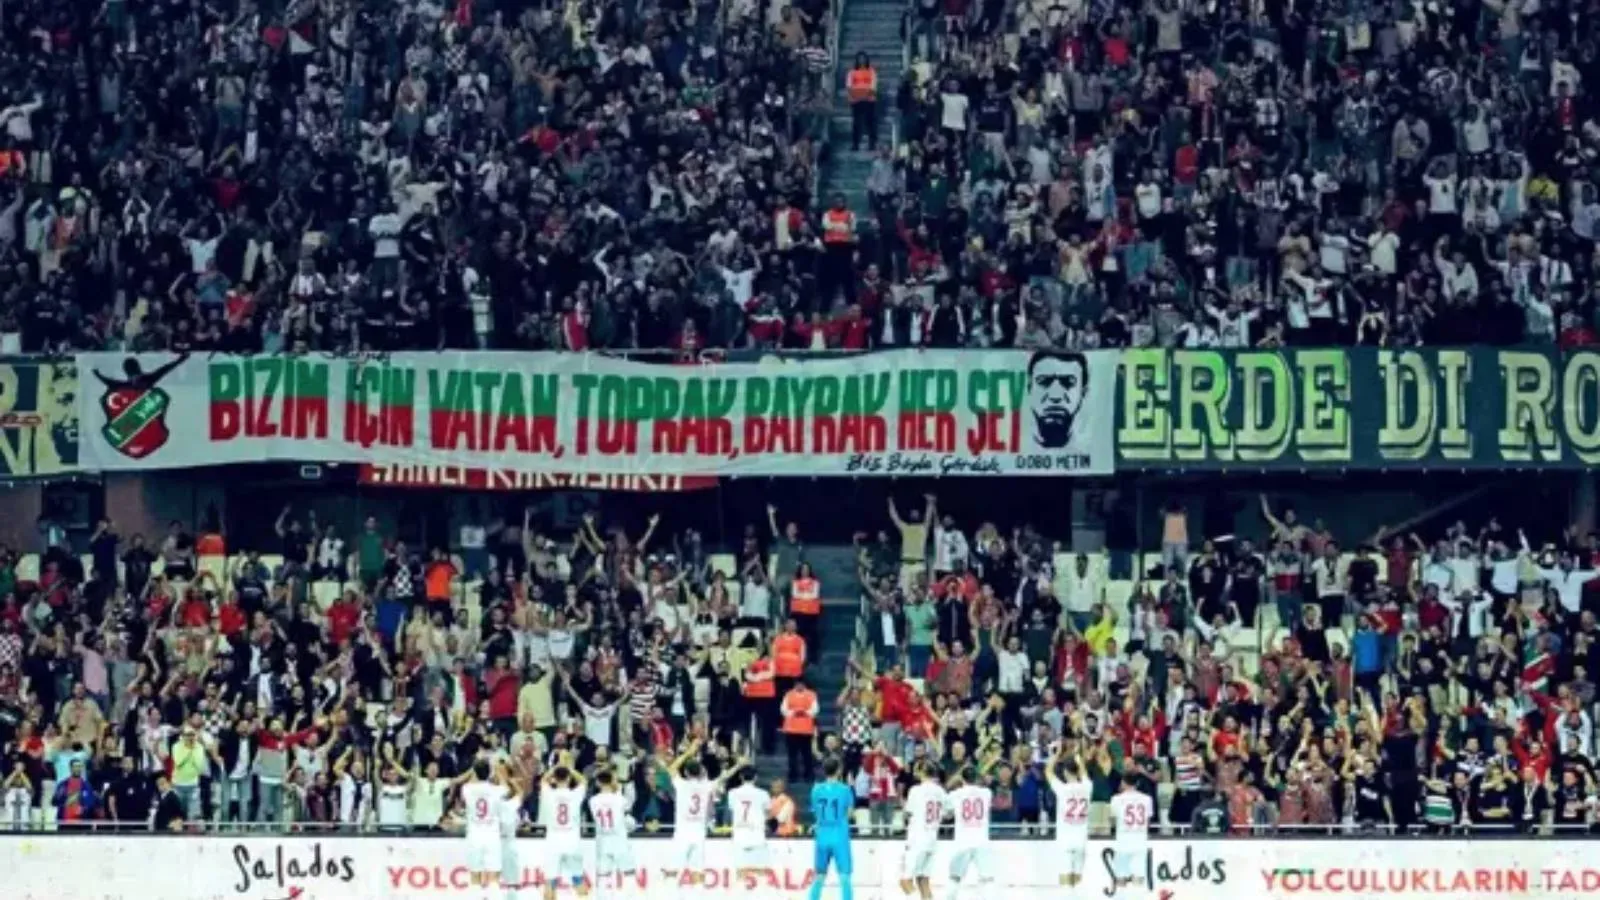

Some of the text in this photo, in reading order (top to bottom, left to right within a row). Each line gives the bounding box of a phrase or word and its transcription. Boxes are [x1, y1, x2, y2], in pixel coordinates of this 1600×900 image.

[428, 368, 565, 459] VATAN,
[572, 373, 738, 460] TOPRAK,
[743, 371, 890, 455] BAYRAK
[896, 368, 957, 454] HER
[967, 368, 1026, 456] ŞEY
[1378, 350, 1473, 459] DI
[475, 797, 488, 819] 9
[557, 803, 569, 825] 8
[688, 793, 701, 815] 3
[740, 800, 753, 823] 7
[817, 798, 839, 820] 71
[962, 798, 984, 821] 80
[1065, 798, 1088, 818] 22
[1125, 803, 1146, 826] 53
[596, 807, 614, 828] 11
[232, 842, 355, 893] Salados
[1101, 845, 1227, 897] Slados
[1262, 868, 1528, 892] YOLCULUKLARIN
